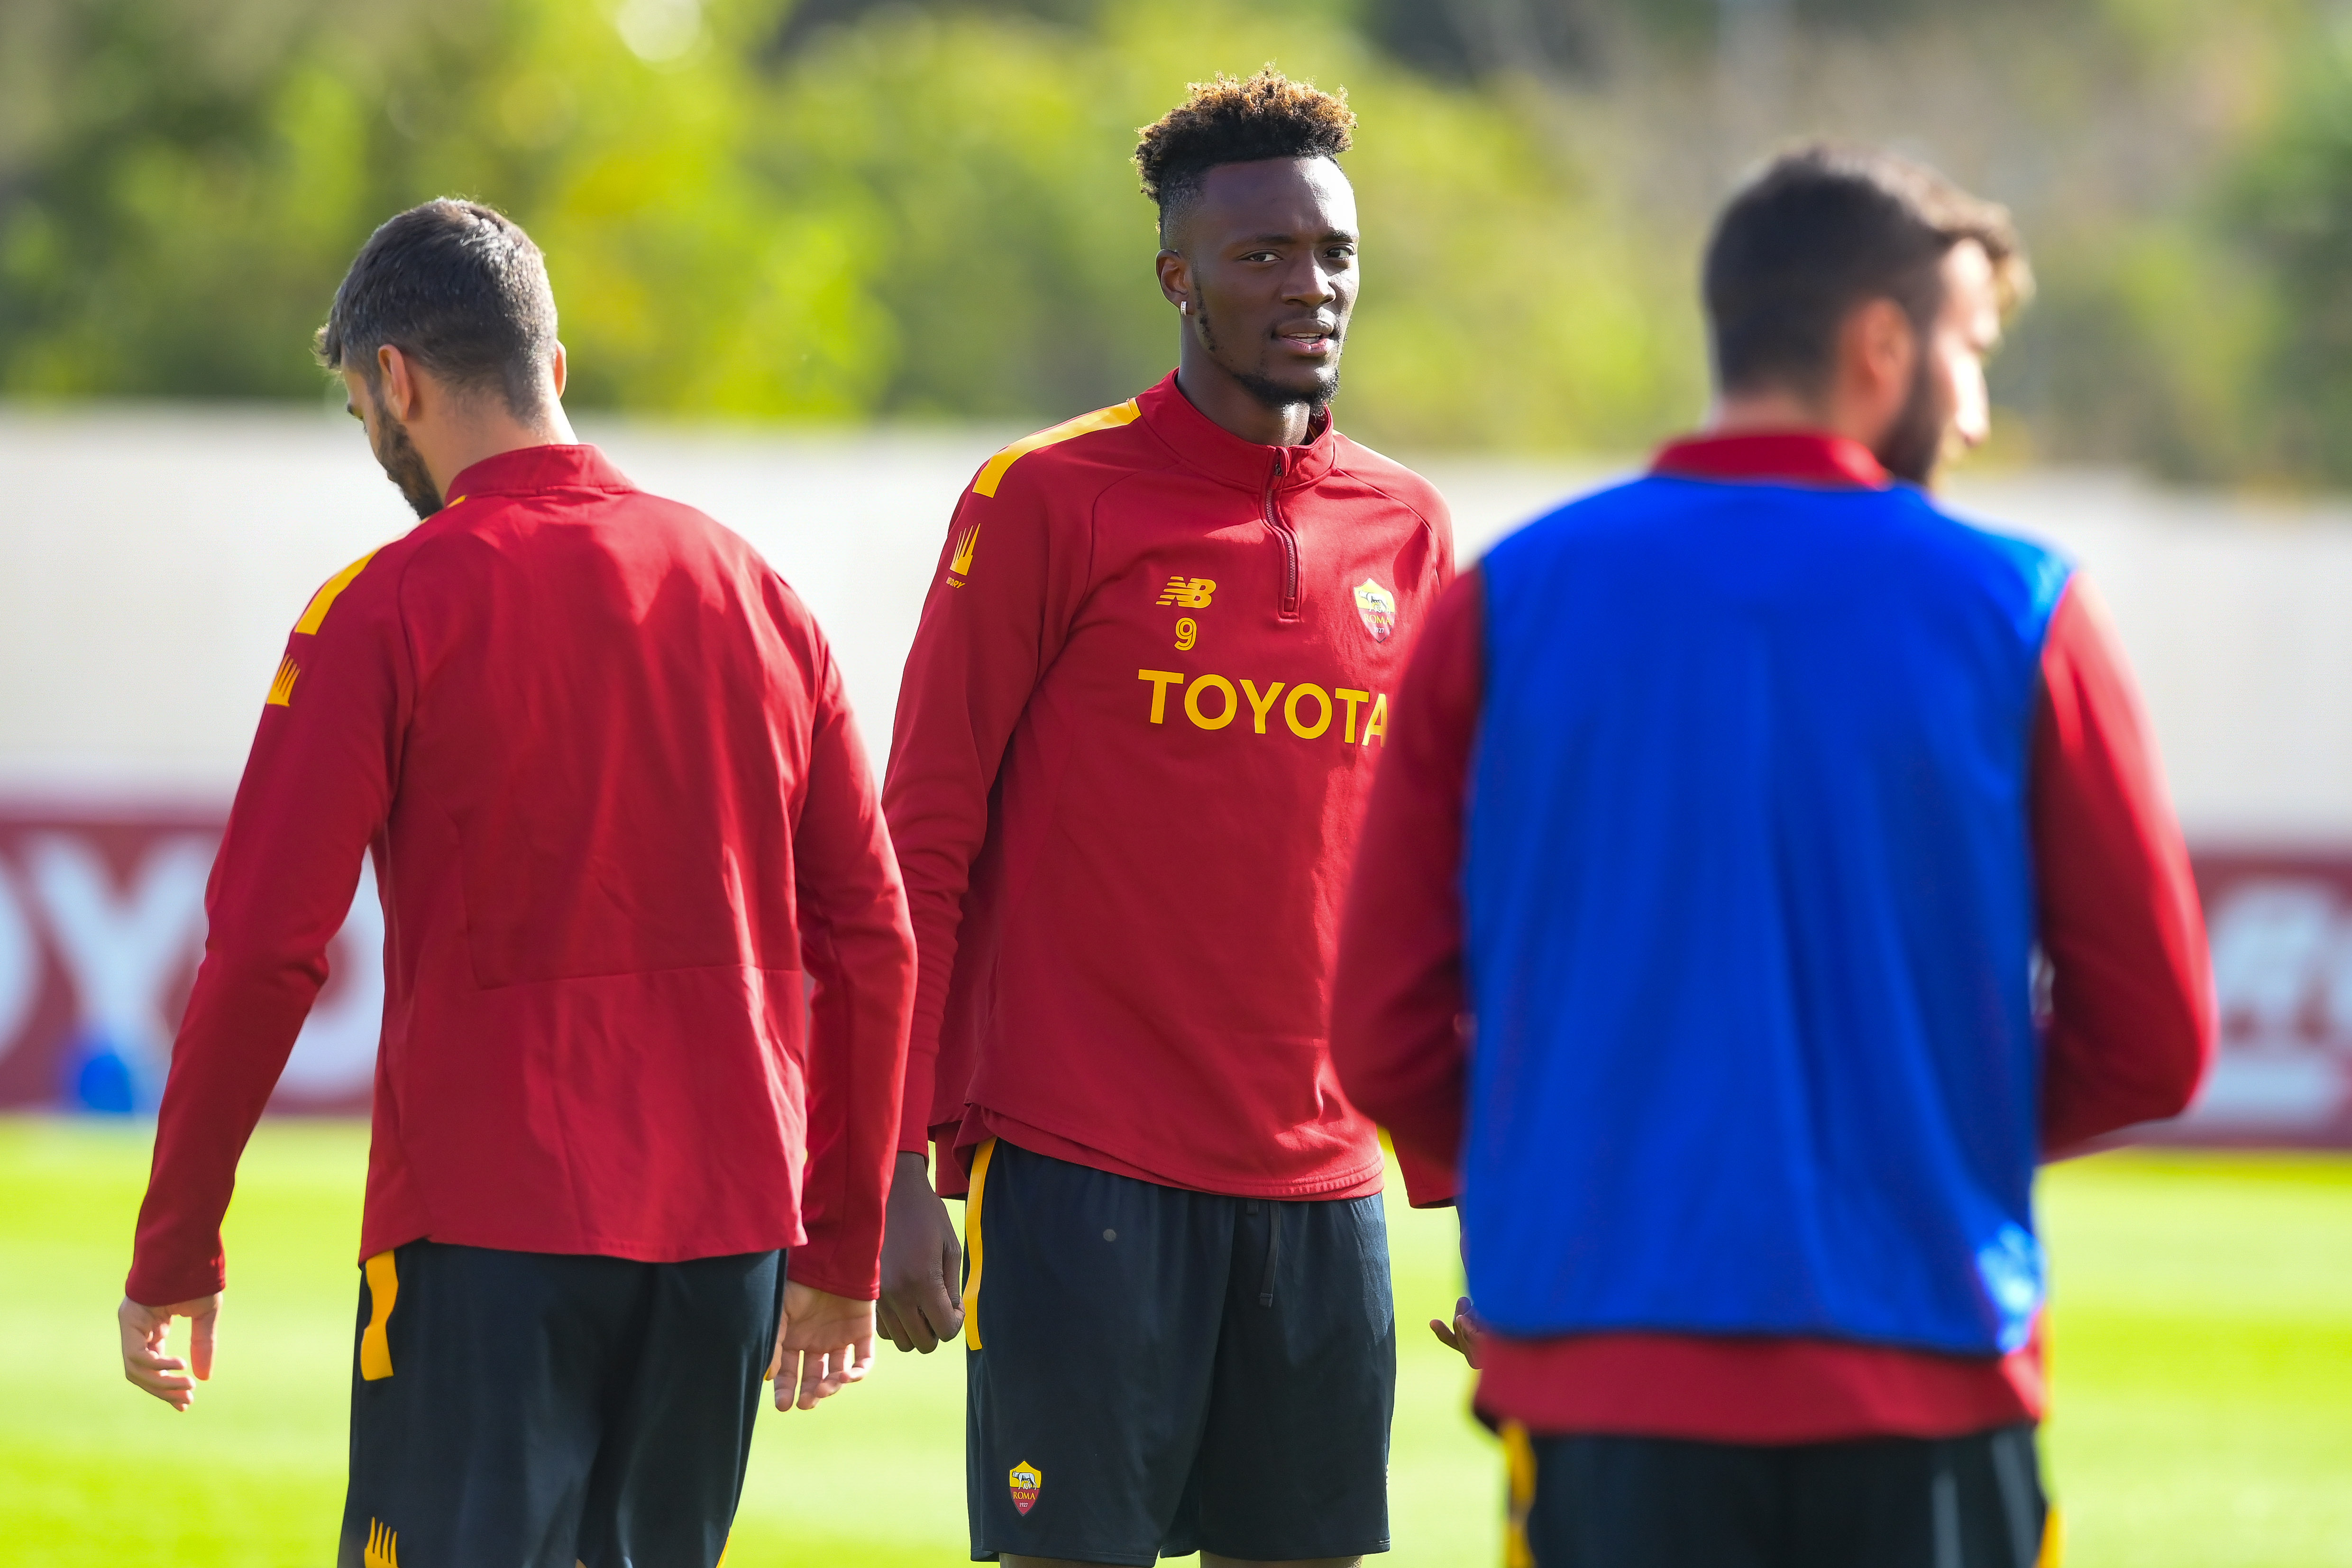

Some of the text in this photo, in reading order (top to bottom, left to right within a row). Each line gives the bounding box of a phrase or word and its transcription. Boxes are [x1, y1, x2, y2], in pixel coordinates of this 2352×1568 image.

[1364, 614, 1392, 625] ROMA
[1174, 617, 1197, 651] 9
[1138, 669, 1388, 747] TOYOTA
[1013, 1491, 1035, 1500] ROMA
